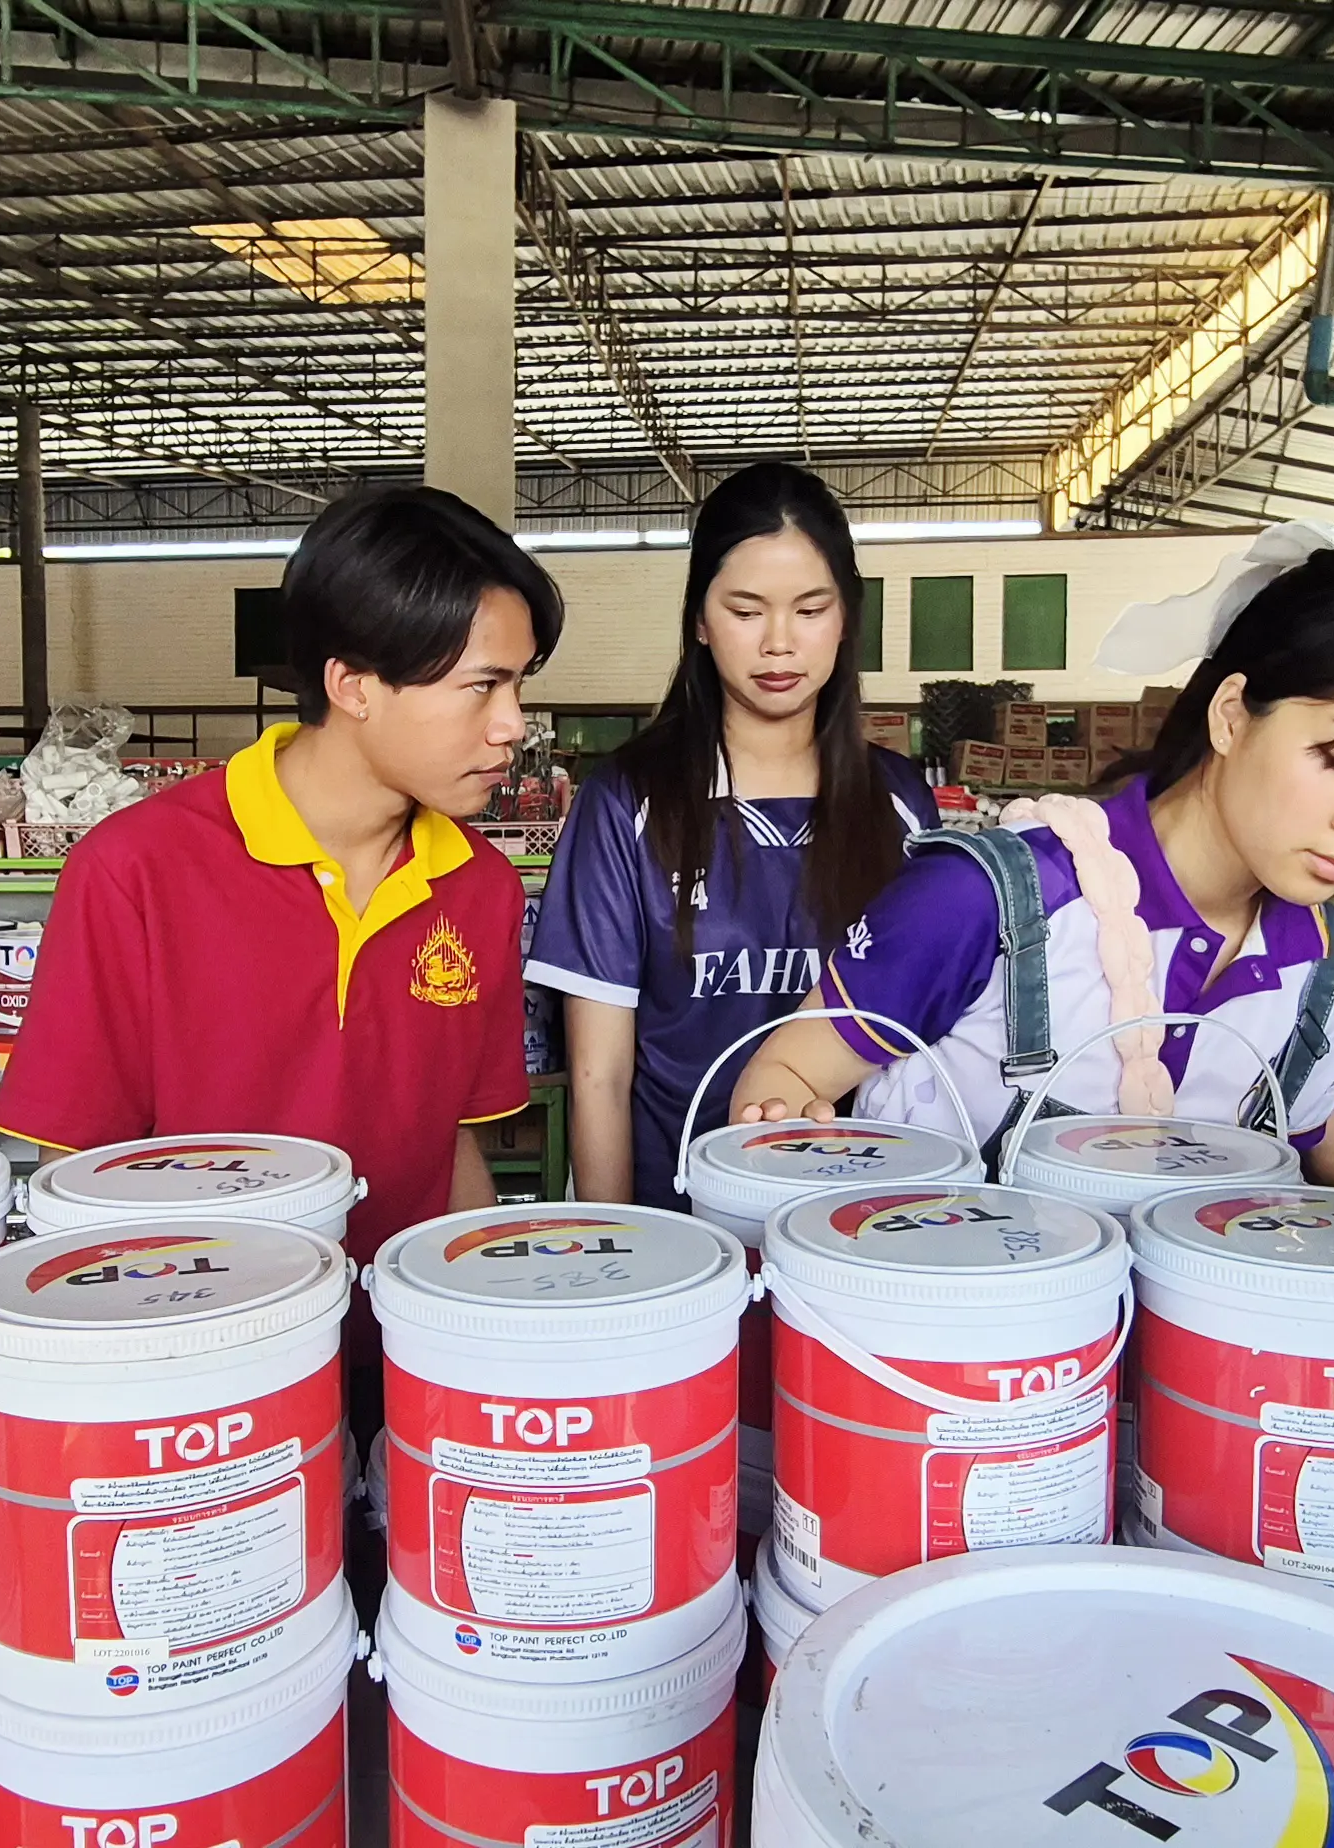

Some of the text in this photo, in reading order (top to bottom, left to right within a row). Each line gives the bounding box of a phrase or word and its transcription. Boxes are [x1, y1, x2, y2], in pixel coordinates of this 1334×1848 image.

[0, 946, 39, 966] TO
[770, 1141, 887, 1159] TOP
[1092, 1135, 1208, 1151] TOP
[126, 1159, 250, 1172] TOP
[871, 1206, 1014, 1233] TOP
[481, 1238, 633, 1257] TOP
[66, 1257, 229, 1286] TOP
[987, 1357, 1080, 1402] TOP
[481, 1402, 593, 1446] TOP
[134, 1412, 253, 1468] TOP
[459, 1635, 477, 1643] TOP
[489, 1632, 508, 1642] TOP
[512, 1635, 540, 1645] PAINT
[544, 1635, 585, 1646] PERFECT
[147, 1664, 167, 1675] TOP
[172, 1657, 202, 1671] PAINT
[206, 1644, 246, 1665] PERFECT
[112, 1677, 133, 1686] TOP
[1042, 1688, 1279, 1843] TOP
[586, 1755, 683, 1816] TOP
[61, 1814, 178, 1848] TOP
